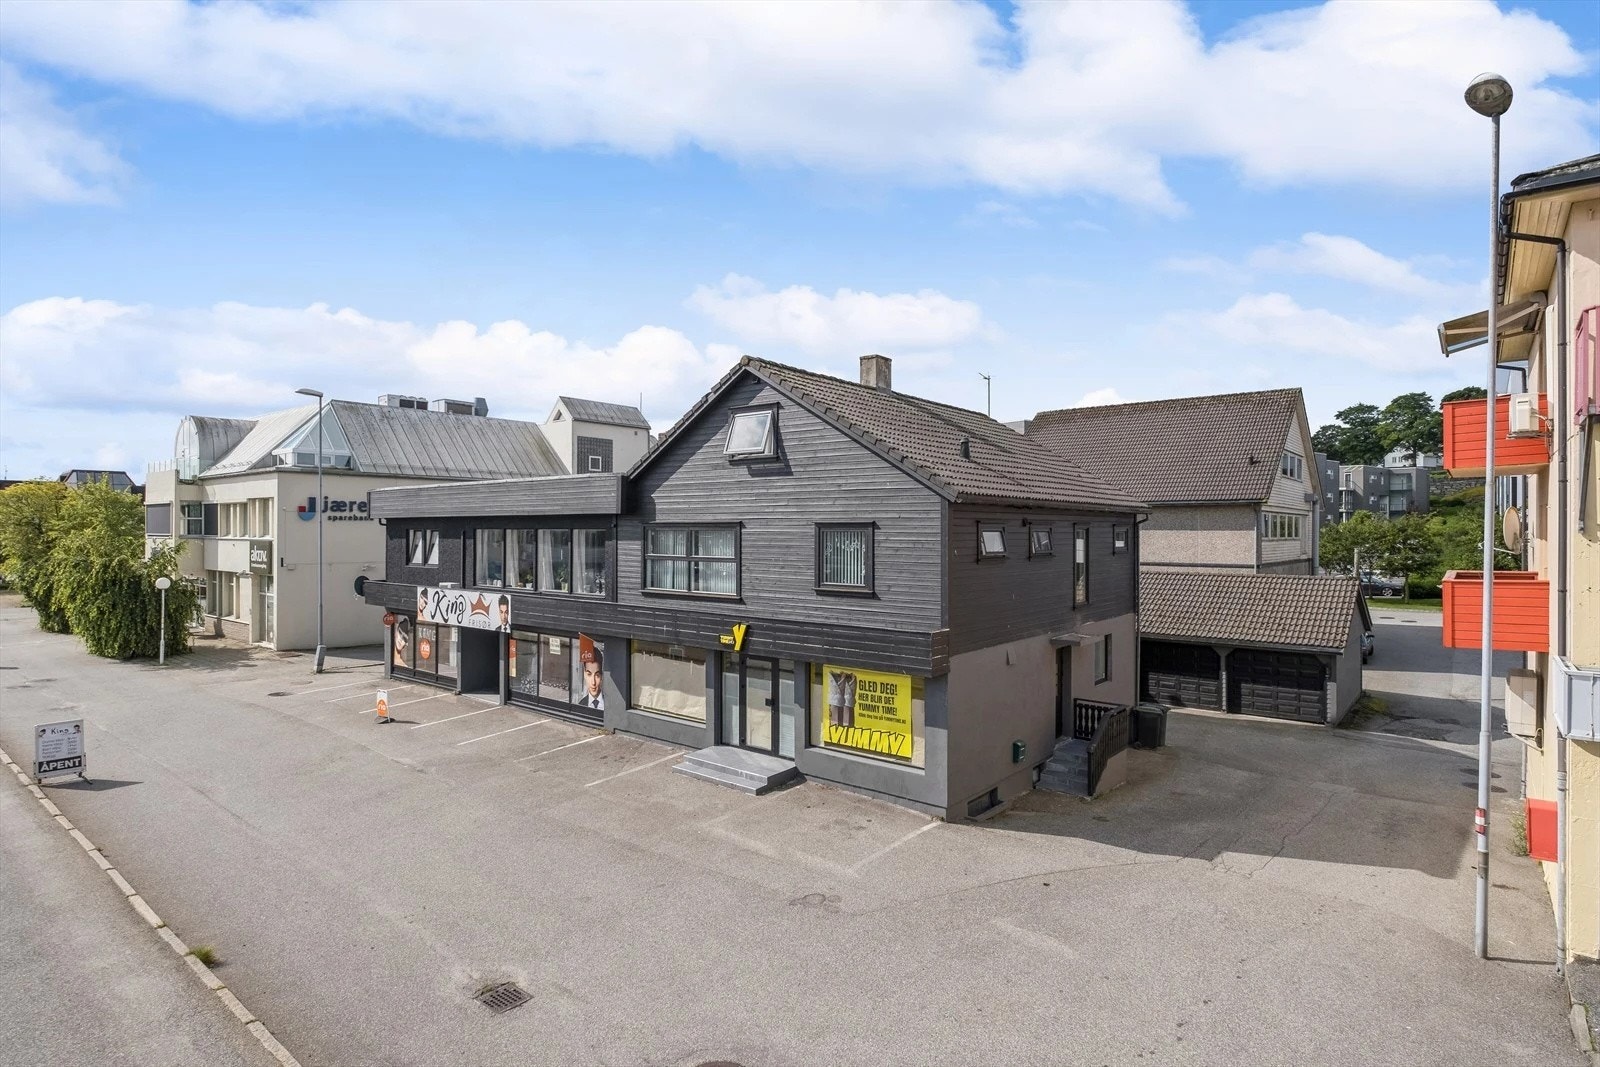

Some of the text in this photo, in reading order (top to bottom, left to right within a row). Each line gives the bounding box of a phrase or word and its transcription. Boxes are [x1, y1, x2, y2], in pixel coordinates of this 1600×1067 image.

[321, 496, 368, 513] jære
[430, 590, 466, 624] King
[468, 619, 491, 628] FRISØR
[858, 680, 898, 696] GLED DEG!
[858, 692, 869, 702] HER
[858, 703, 898, 717] YUMMY TIME!
[829, 724, 905, 756] YUMMY
[41, 759, 80, 771] ÅPENT
